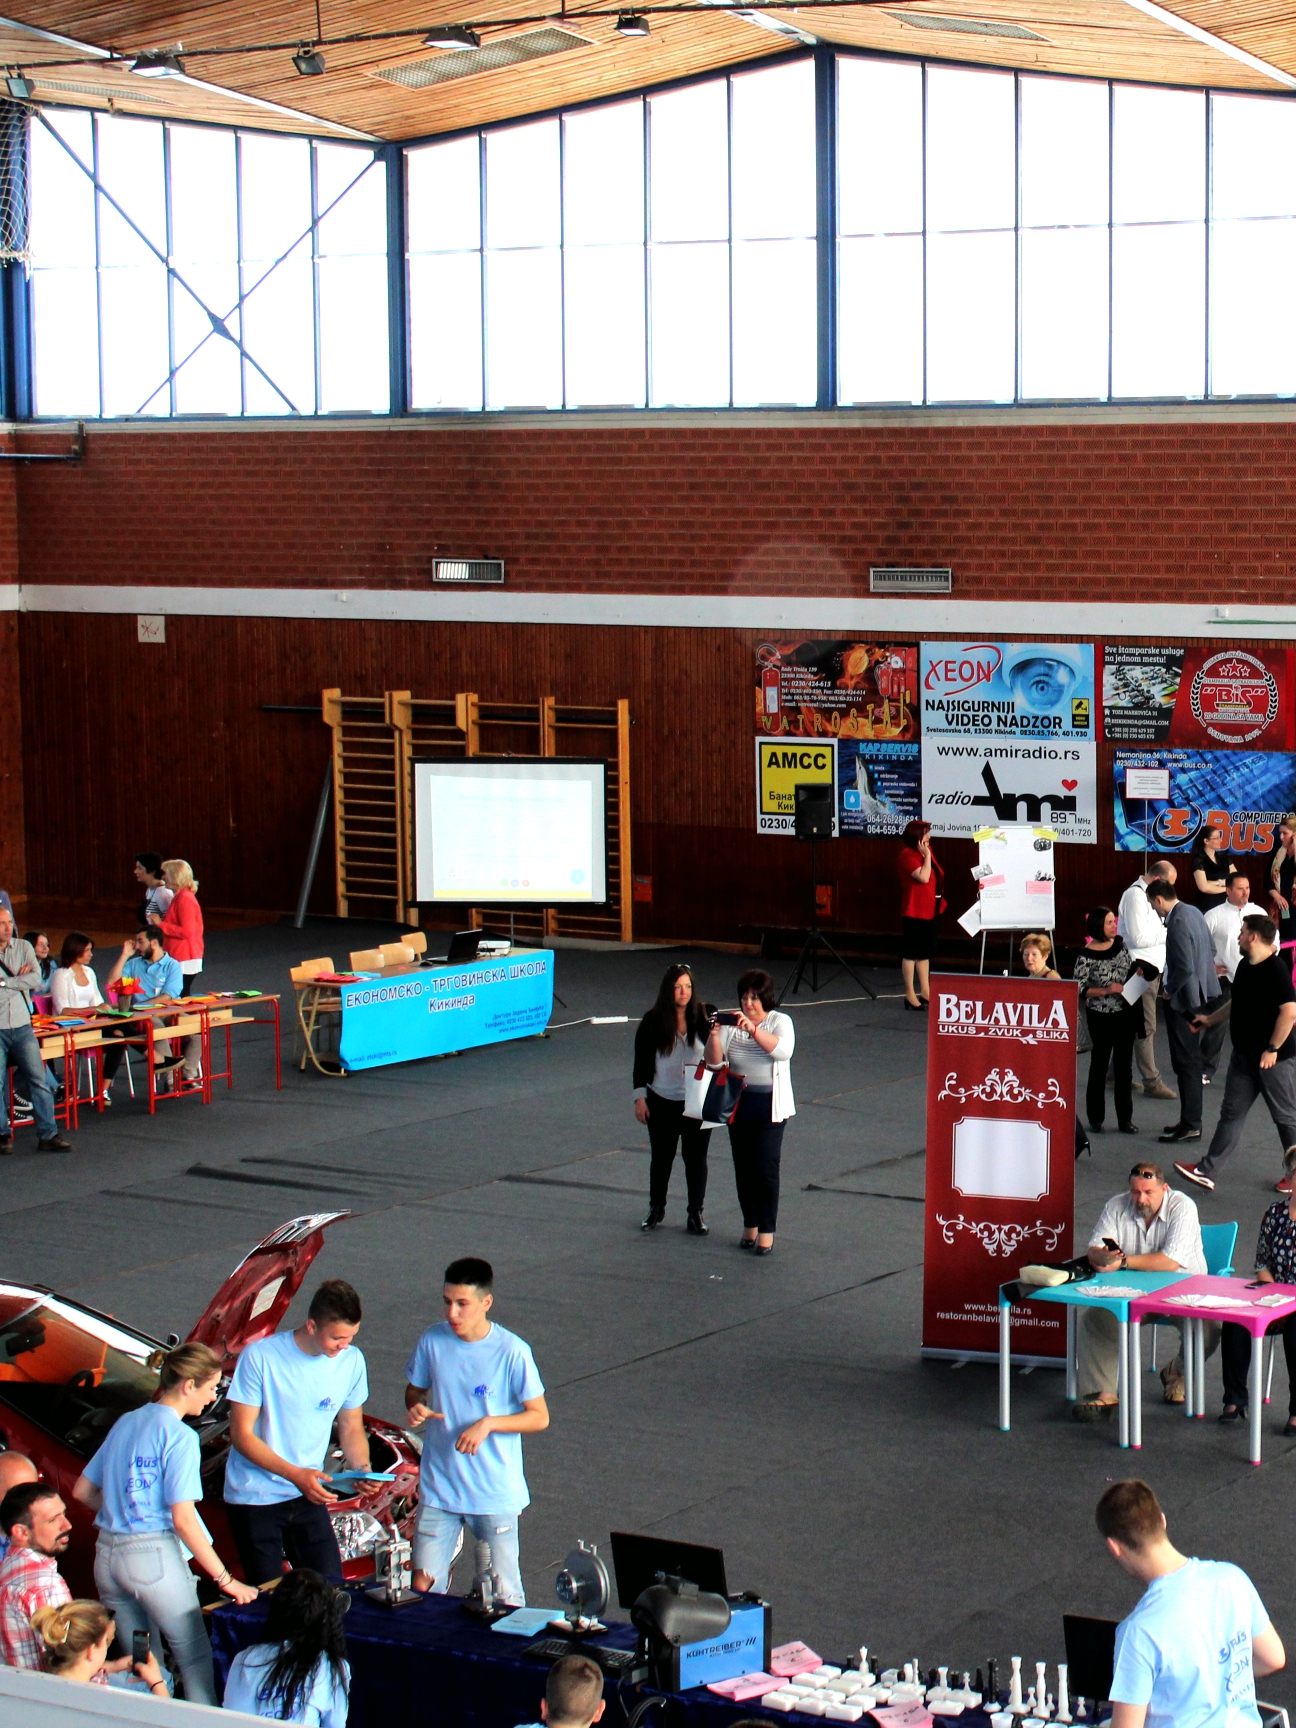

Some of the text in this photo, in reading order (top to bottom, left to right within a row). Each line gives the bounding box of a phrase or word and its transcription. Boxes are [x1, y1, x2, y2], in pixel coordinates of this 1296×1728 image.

[1118, 646, 1160, 655] štamparske
[1161, 647, 1184, 656] usluge
[1115, 655, 1141, 663] jednom
[924, 659, 993, 687] XEON
[925, 699, 1015, 714] NAJSIGURNIJI
[945, 713, 992, 727] VIDEO
[997, 716, 1063, 730] NADZOR
[926, 726, 962, 734] Svetosavska
[937, 745, 1081, 760] www.amiradio.rs
[1116, 751, 1151, 760] Nemanjina
[1163, 752, 1187, 760] Kikinda
[1116, 760, 1213, 769] 0230/432-102 www.bus.co.rs
[927, 791, 972, 805] radio
[1050, 812, 1077, 824] 89.7
[947, 823, 972, 832] Jovina
[346, 984, 423, 1009] ЕКОНОМСКО
[432, 968, 507, 993] ТРГОВИНСКА
[508, 961, 547, 979] ШКОЛА
[428, 993, 476, 1013] Кикинда
[938, 993, 1069, 1029] BELAVILA
[939, 1024, 1069, 1040] UKUS ZVUK SLIKA
[686, 1640, 742, 1659] KÜHTREIBER
